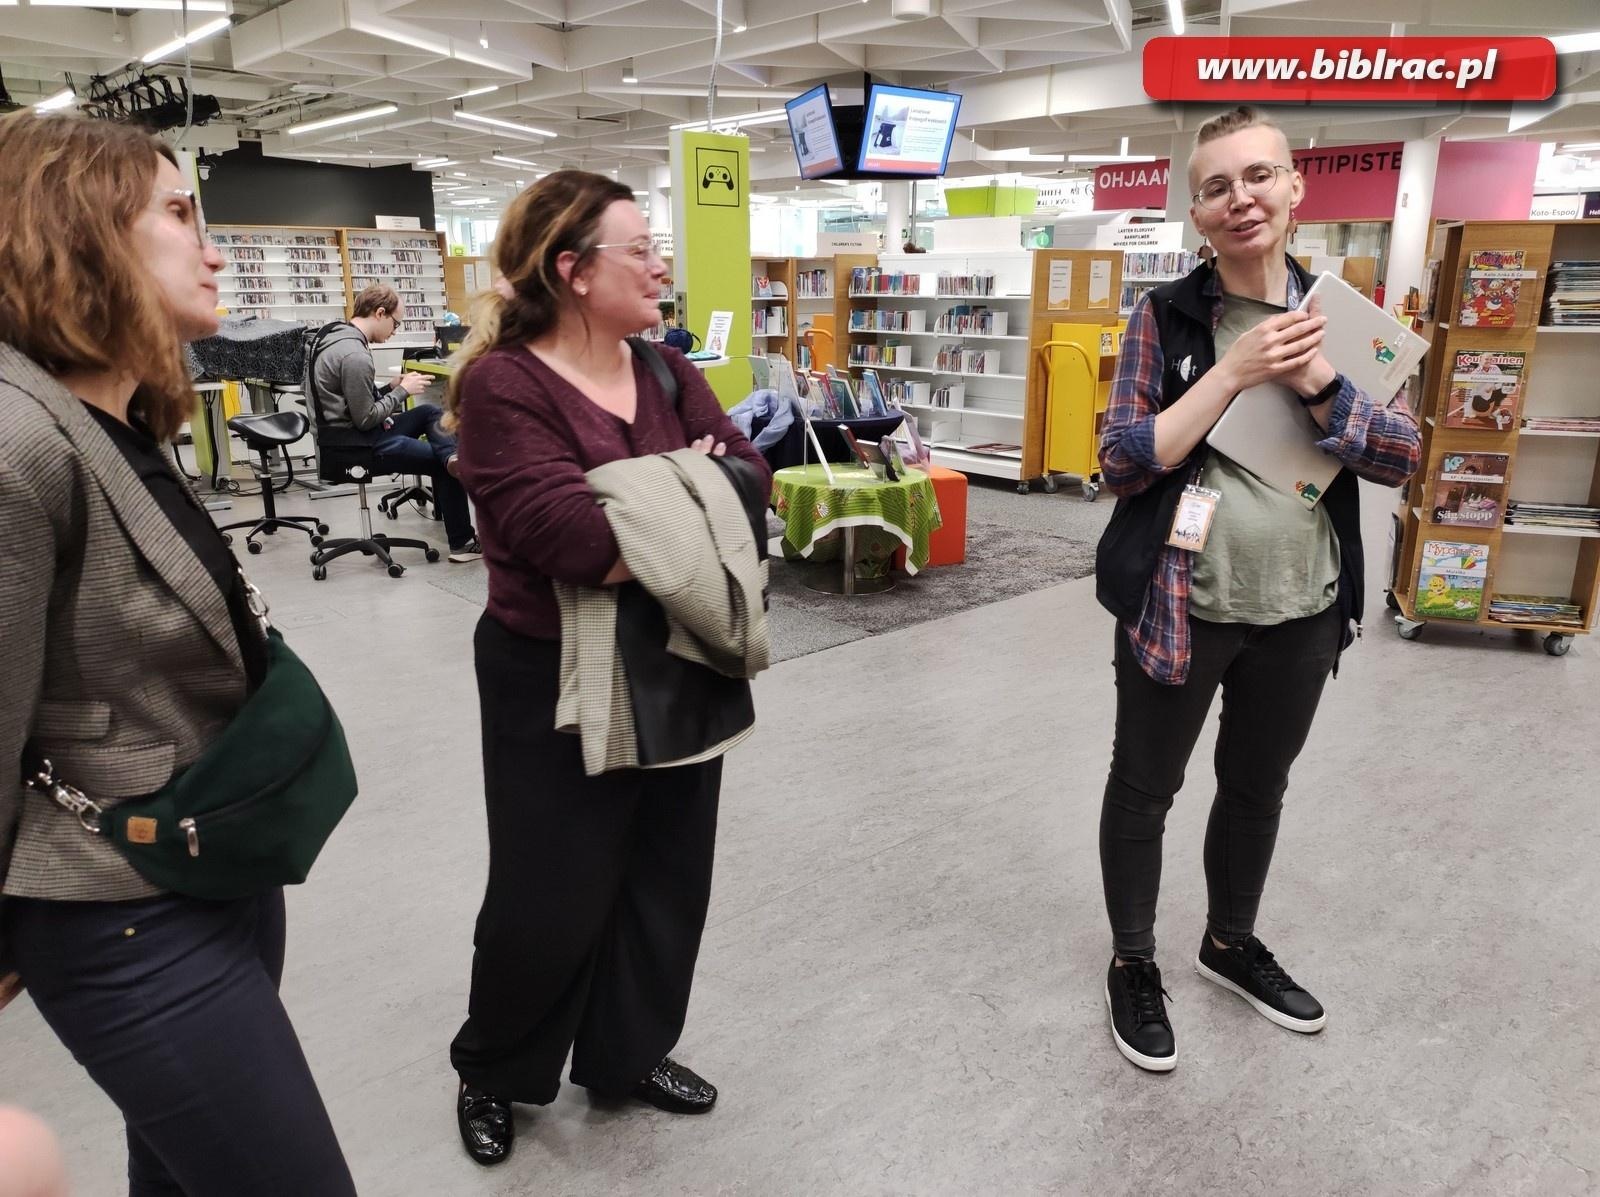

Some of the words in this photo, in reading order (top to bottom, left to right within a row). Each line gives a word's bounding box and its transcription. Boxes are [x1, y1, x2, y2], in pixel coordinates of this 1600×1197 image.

[1531, 209, 1576, 217] Koto-Espoo
[1457, 354, 1524, 367] Kouainen
[1444, 456, 1465, 473] KP
[1460, 510, 1493, 521] stopp
